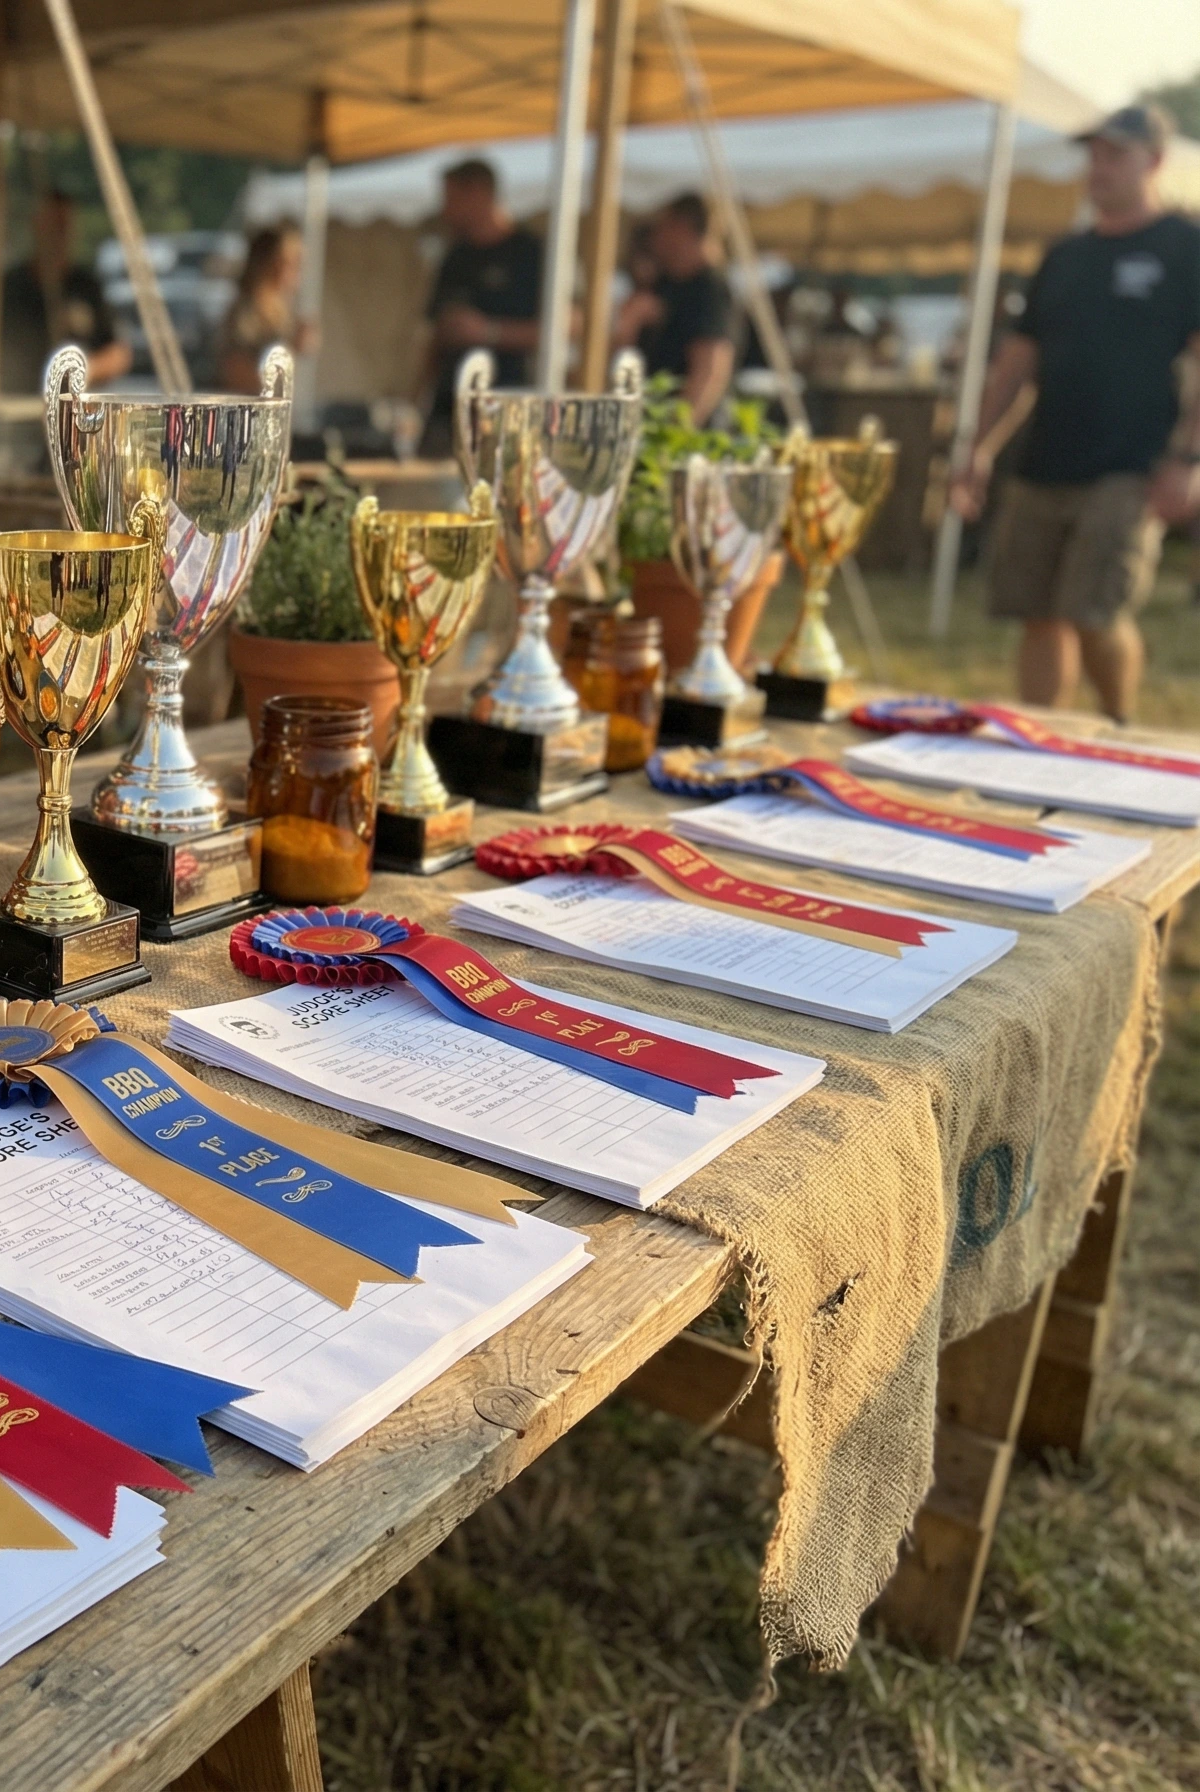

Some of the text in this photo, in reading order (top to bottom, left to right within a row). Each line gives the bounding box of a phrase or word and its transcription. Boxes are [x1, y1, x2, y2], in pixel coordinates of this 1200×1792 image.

[445, 961, 490, 989] BBQ
[101, 1067, 159, 1100] BBQ
[122, 1086, 182, 1120] CHAMPION
[34, 1117, 80, 1142] SHE
[217, 1147, 281, 1178] PLACE
